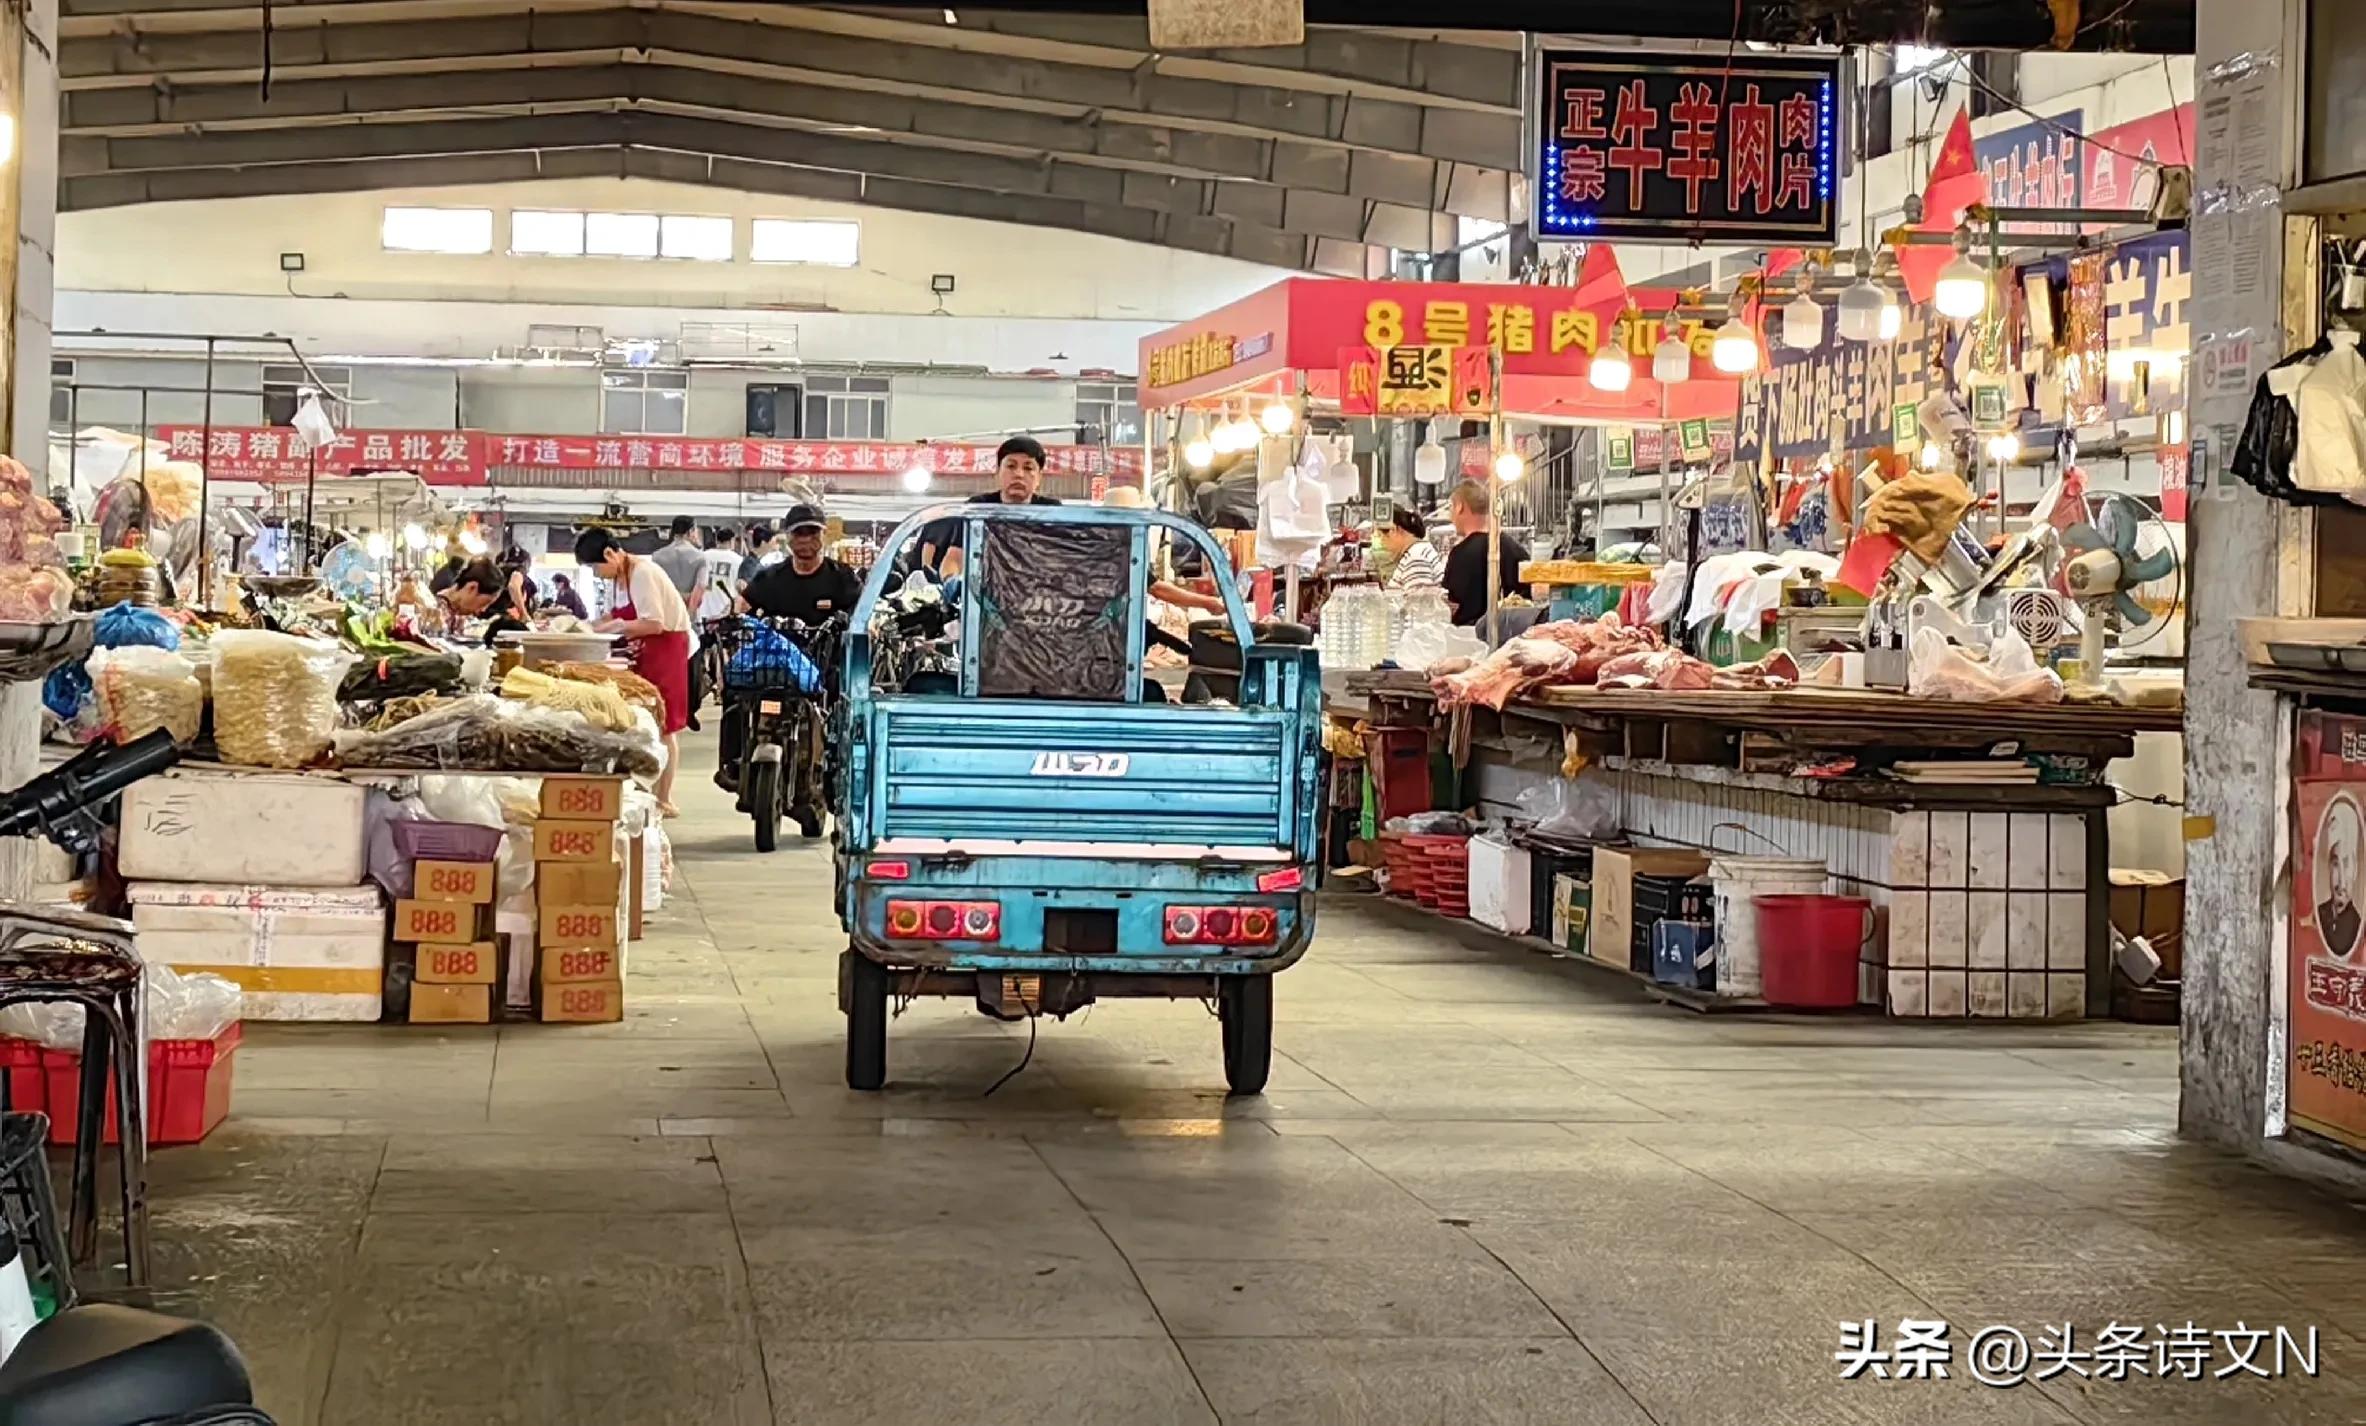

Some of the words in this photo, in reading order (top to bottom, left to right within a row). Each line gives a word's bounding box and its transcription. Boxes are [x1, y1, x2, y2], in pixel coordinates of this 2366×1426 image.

[1561, 88, 1606, 201] 正宗
[1608, 79, 1774, 214] 牛羊肉
[1775, 92, 1818, 209] 肉片
[431, 869, 475, 893] 888
[411, 910, 456, 933] 888
[557, 914, 602, 938] 888
[432, 952, 478, 975] 888
[561, 990, 606, 1013] 888
